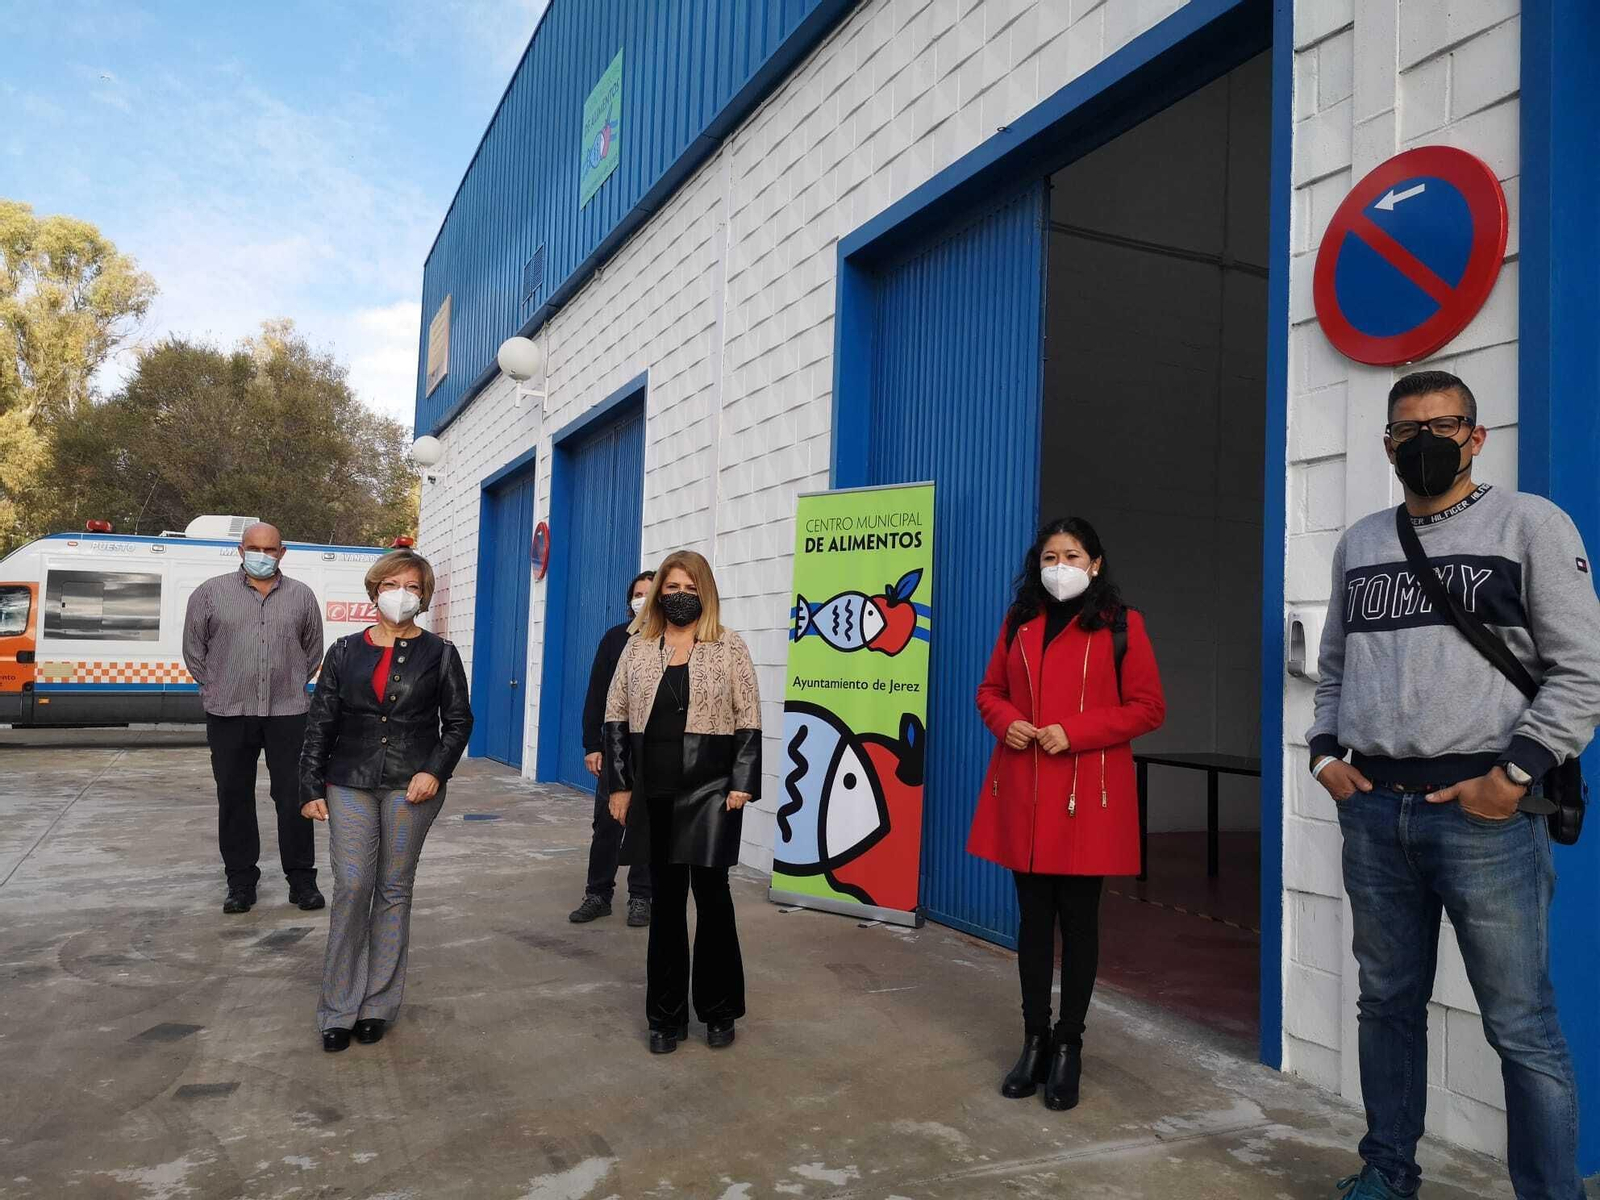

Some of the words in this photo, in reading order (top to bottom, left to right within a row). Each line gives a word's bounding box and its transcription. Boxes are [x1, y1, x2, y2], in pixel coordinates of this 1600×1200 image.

[591, 77, 620, 129] ALIMENTOS
[805, 516, 854, 533] CENTRO
[856, 511, 923, 530] MUNICIPAL
[1431, 500, 1470, 523] HILFIGER
[90, 541, 136, 552] PUESTO
[804, 536, 825, 553] DE
[827, 531, 923, 552] ALIMENTOS
[349, 603, 378, 617] 112
[792, 676, 869, 691] Ayuntamiento
[872, 679, 886, 691] de
[888, 679, 920, 694] Jerez
